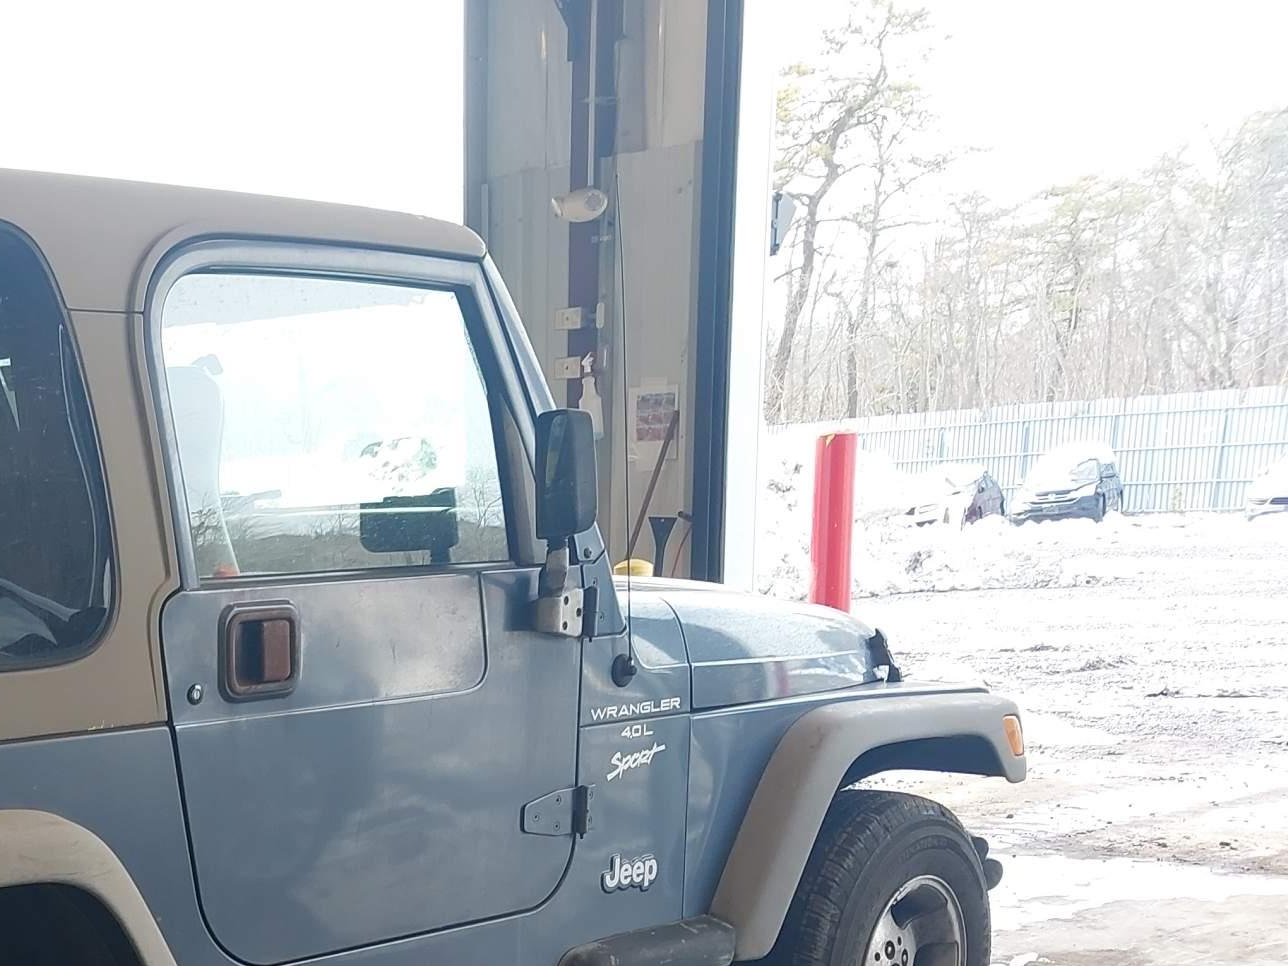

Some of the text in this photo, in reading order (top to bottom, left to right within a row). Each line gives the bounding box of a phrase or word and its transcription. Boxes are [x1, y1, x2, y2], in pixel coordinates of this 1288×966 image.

[590, 696, 681, 721] WRANGLER
[606, 741, 666, 782] Sport
[602, 853, 658, 892] Jeep
